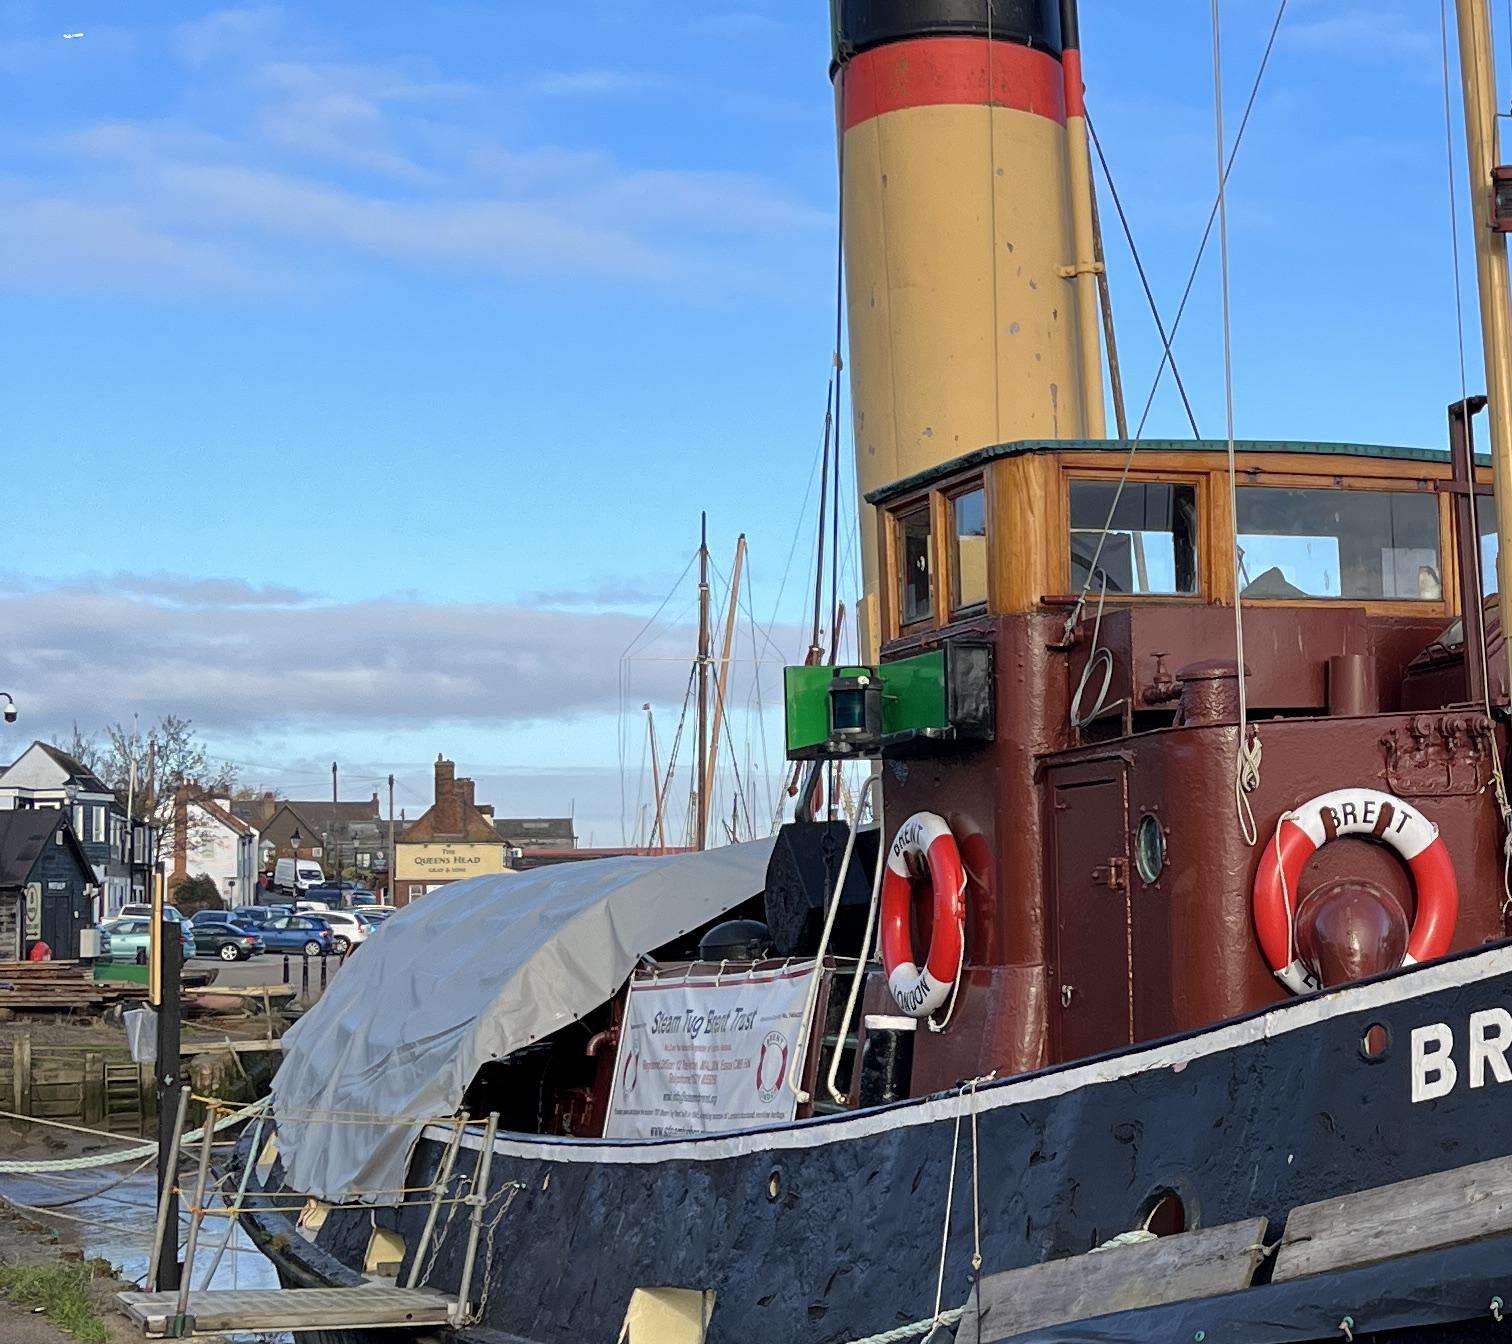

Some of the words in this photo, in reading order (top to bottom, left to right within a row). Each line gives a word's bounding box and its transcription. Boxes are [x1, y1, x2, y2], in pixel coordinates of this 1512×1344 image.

[1328, 800, 1413, 834] BRET
[414, 856, 450, 866] QUEENS
[453, 855, 481, 864] HEAD
[652, 1010, 681, 1034] Steam
[682, 1008, 704, 1039] Tug
[704, 1009, 731, 1034] Brent
[731, 1007, 758, 1032] Trust
